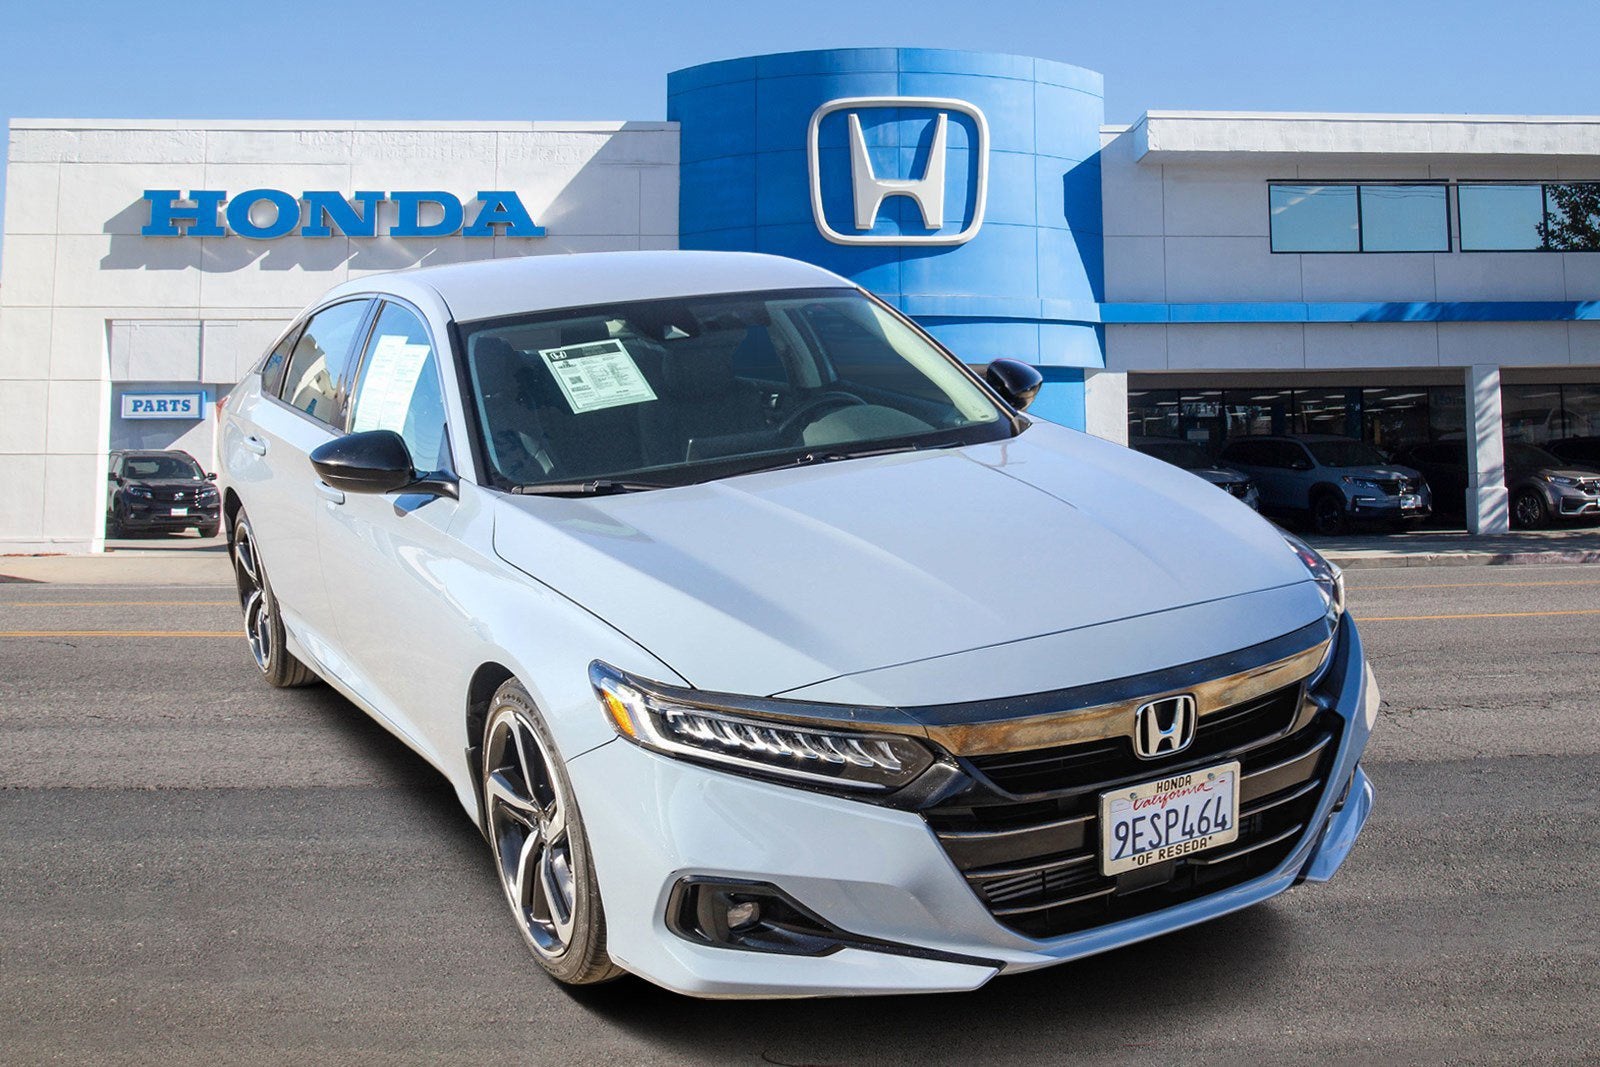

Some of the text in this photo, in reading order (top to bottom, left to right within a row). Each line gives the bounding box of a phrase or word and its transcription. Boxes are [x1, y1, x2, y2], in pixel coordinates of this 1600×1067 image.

[142, 188, 548, 239] HONDA
[131, 399, 191, 412] PARTS
[1132, 781, 1213, 811] California
[1156, 774, 1192, 793] HONDA
[1112, 796, 1227, 860] 9ESP464
[1137, 837, 1208, 866] OF RESEDA
